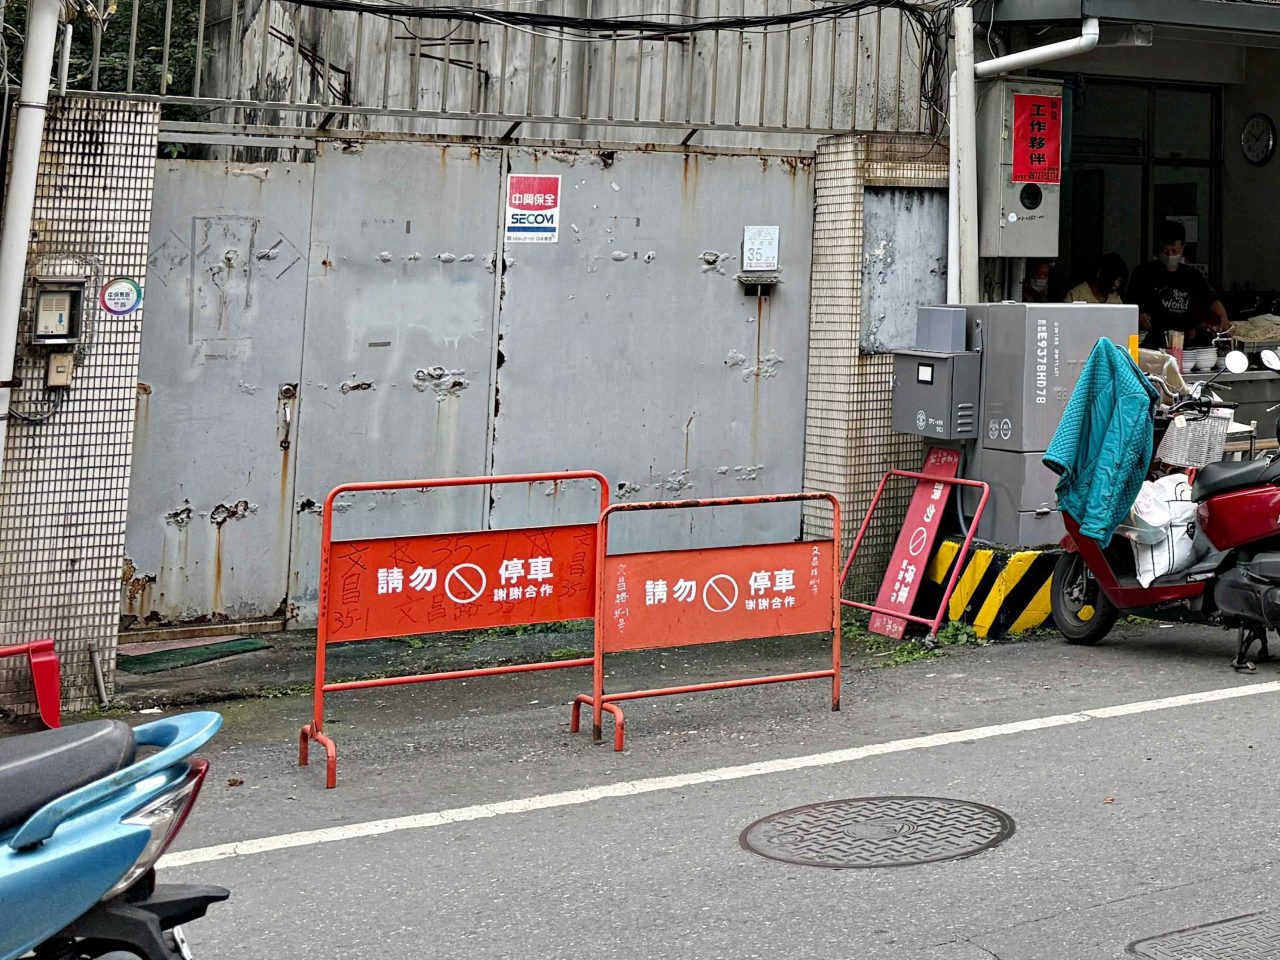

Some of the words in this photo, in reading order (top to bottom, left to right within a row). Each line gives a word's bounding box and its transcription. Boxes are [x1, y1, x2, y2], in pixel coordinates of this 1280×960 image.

[1029, 104, 1046, 165] 工作夥伴
[512, 193, 555, 206] 中興保全
[511, 214, 554, 224] SECOM
[377, 566, 438, 595] 請勿
[498, 556, 554, 585] 停車
[748, 568, 796, 596] 停車
[493, 584, 554, 602] 謝謝合作
[645, 578, 697, 606] 請勿
[745, 596, 796, 611] 謝謝合作
